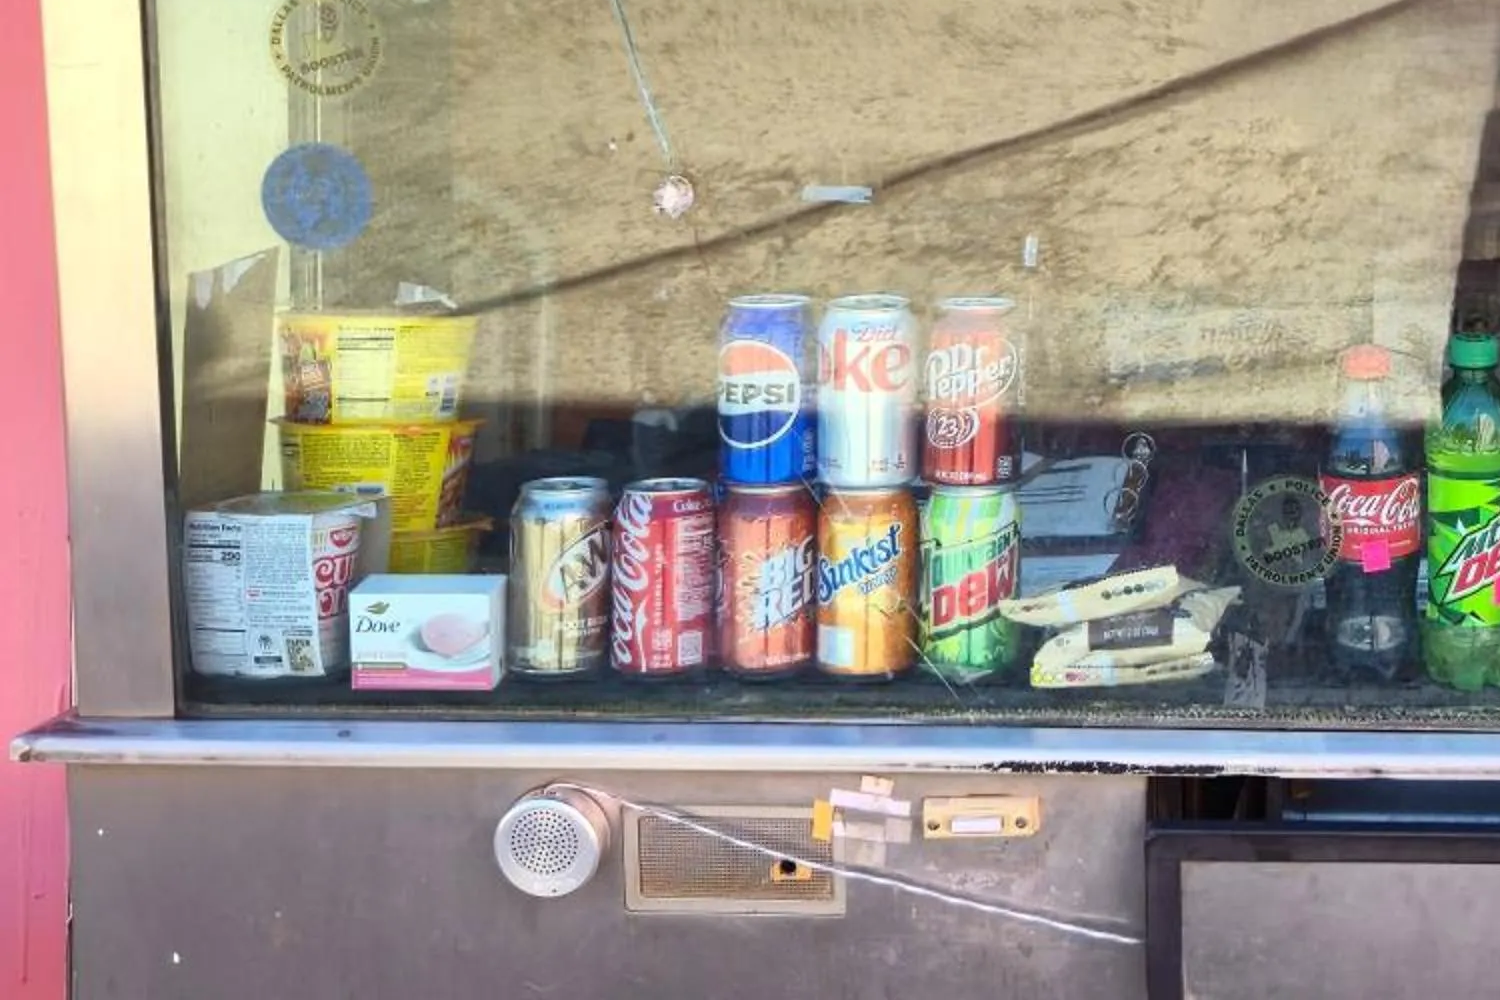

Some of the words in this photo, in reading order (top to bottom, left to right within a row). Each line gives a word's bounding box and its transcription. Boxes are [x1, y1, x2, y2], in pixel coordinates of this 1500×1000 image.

[719, 383, 795, 406] PEPSI
[937, 416, 959, 437] 23
[1327, 477, 1420, 526] Coca-Cola
[817, 523, 903, 603] Sunkist
[355, 615, 401, 634] Dove
